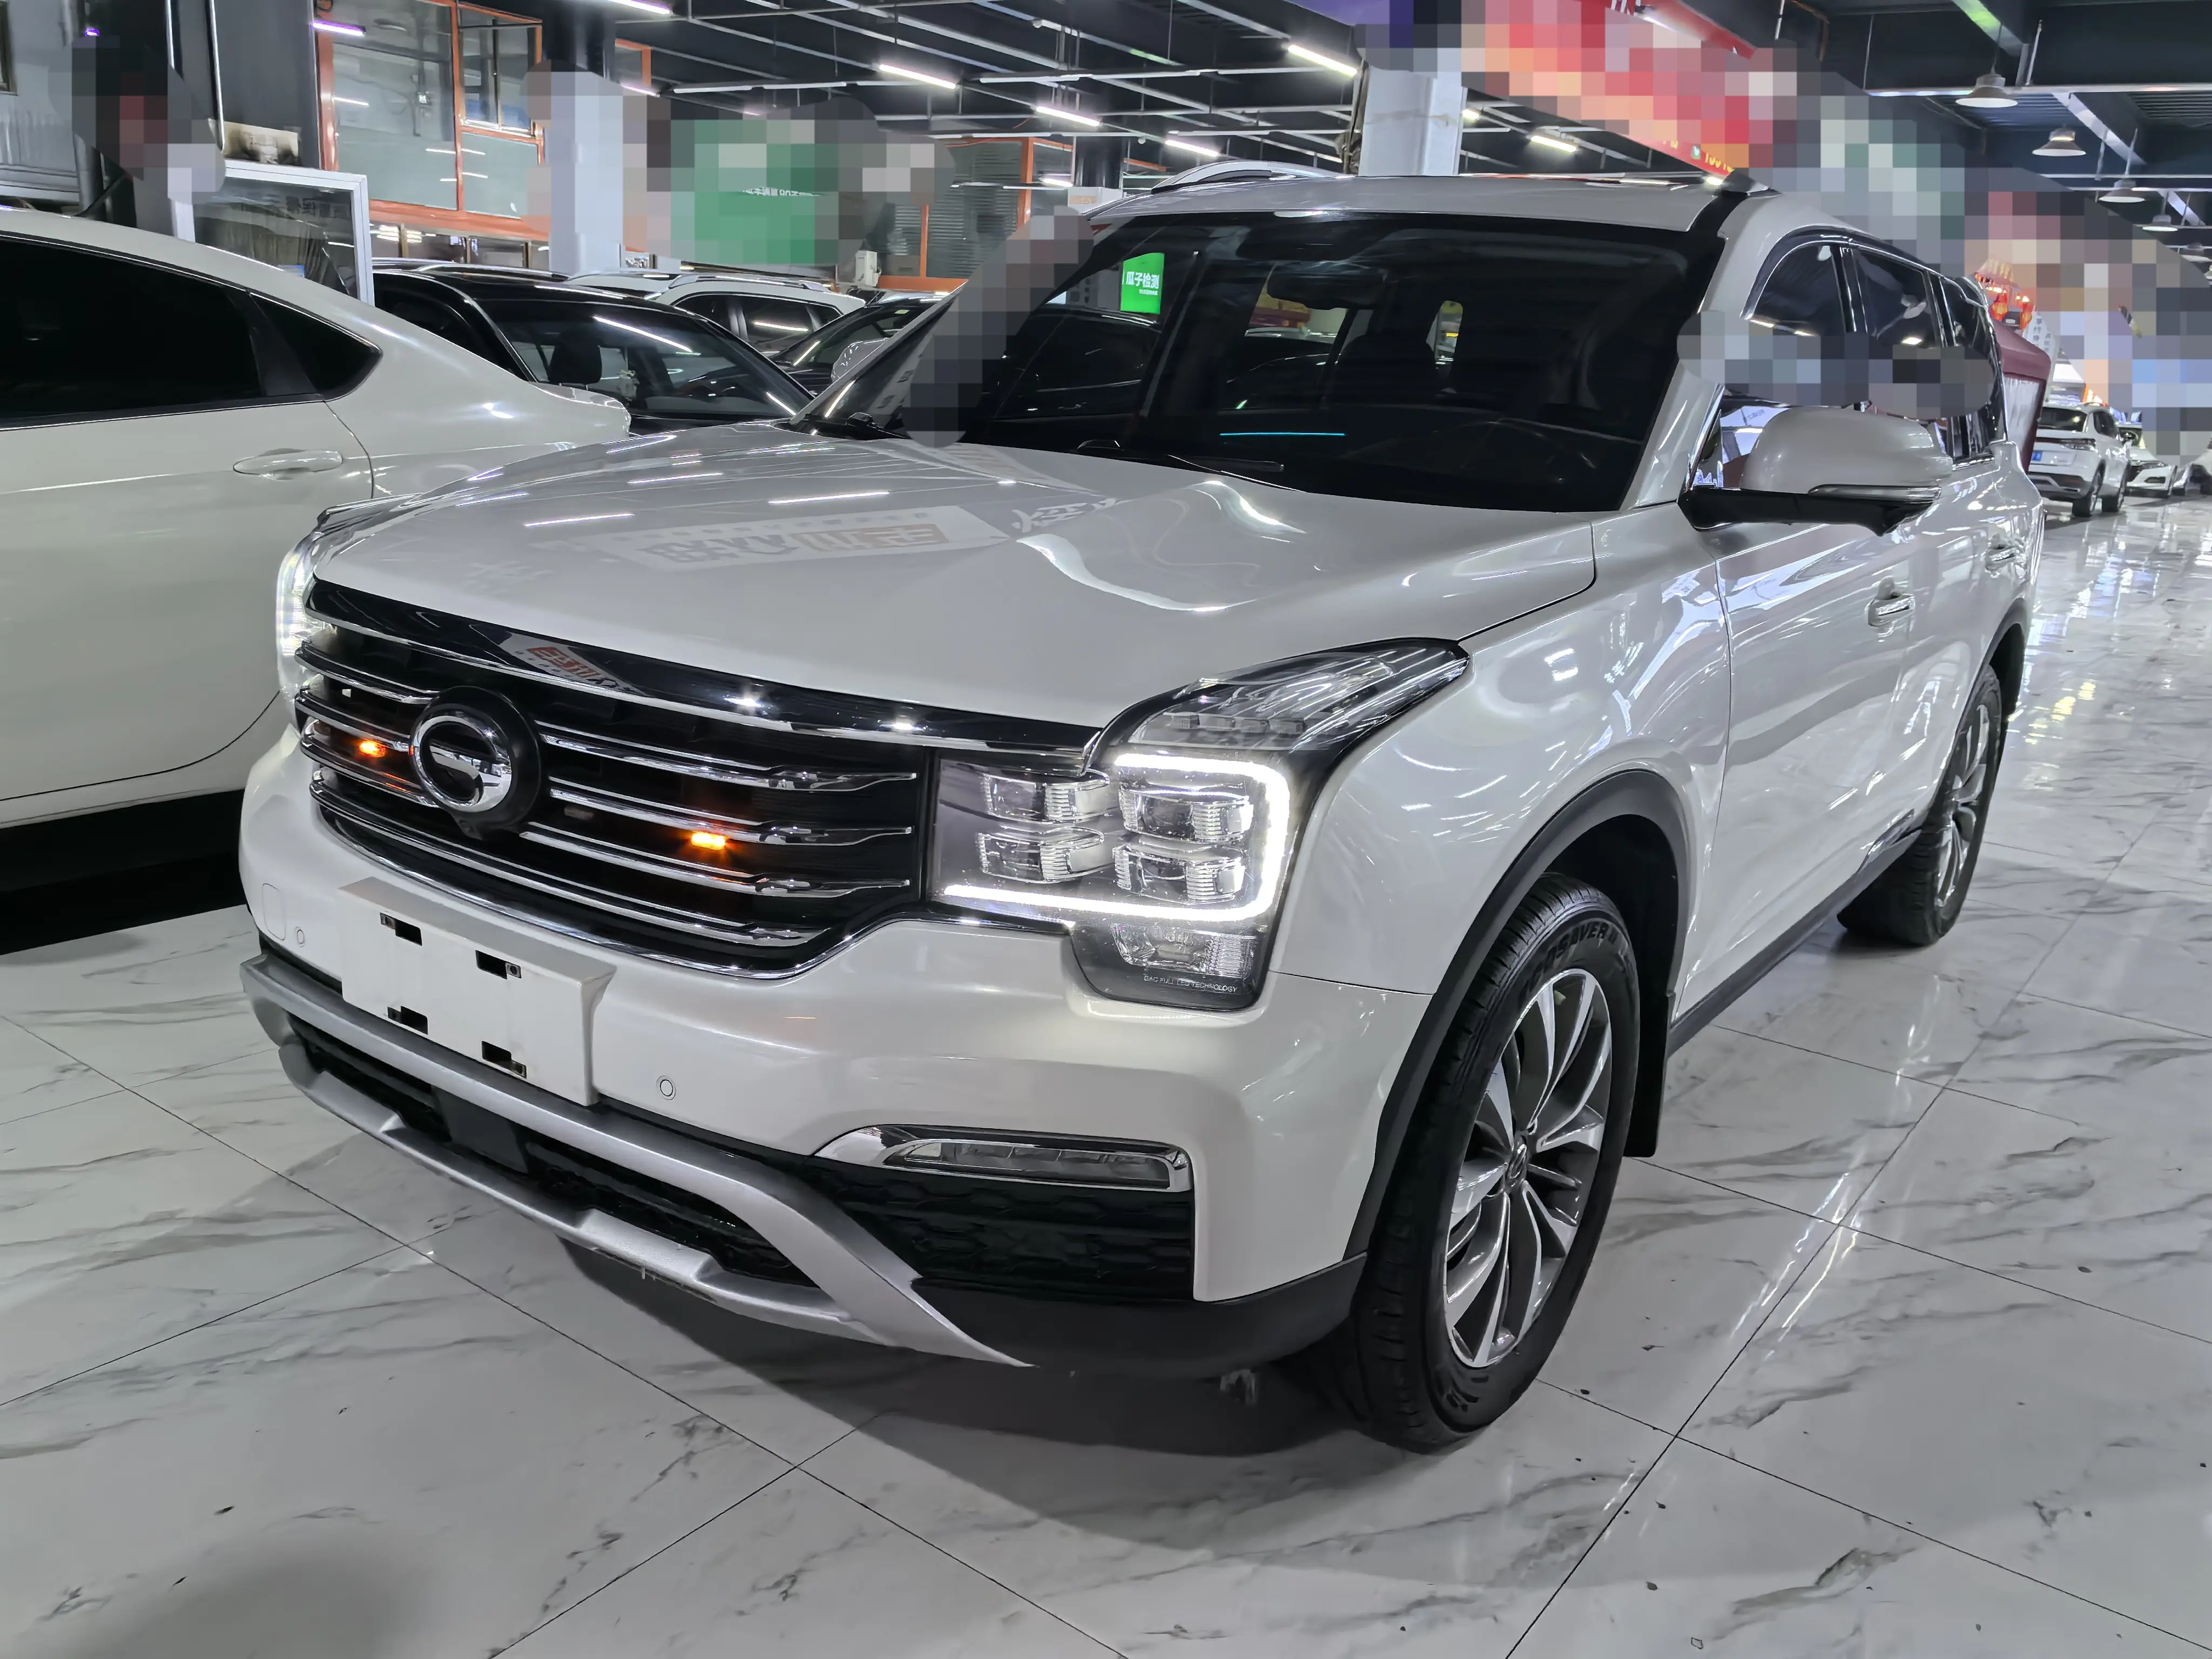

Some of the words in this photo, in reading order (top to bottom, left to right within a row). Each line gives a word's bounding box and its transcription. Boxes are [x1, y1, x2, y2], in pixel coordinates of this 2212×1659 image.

[1126, 272, 1159, 288] 瓜子检测
[1191, 982, 1238, 993] TECHNOLOGY
